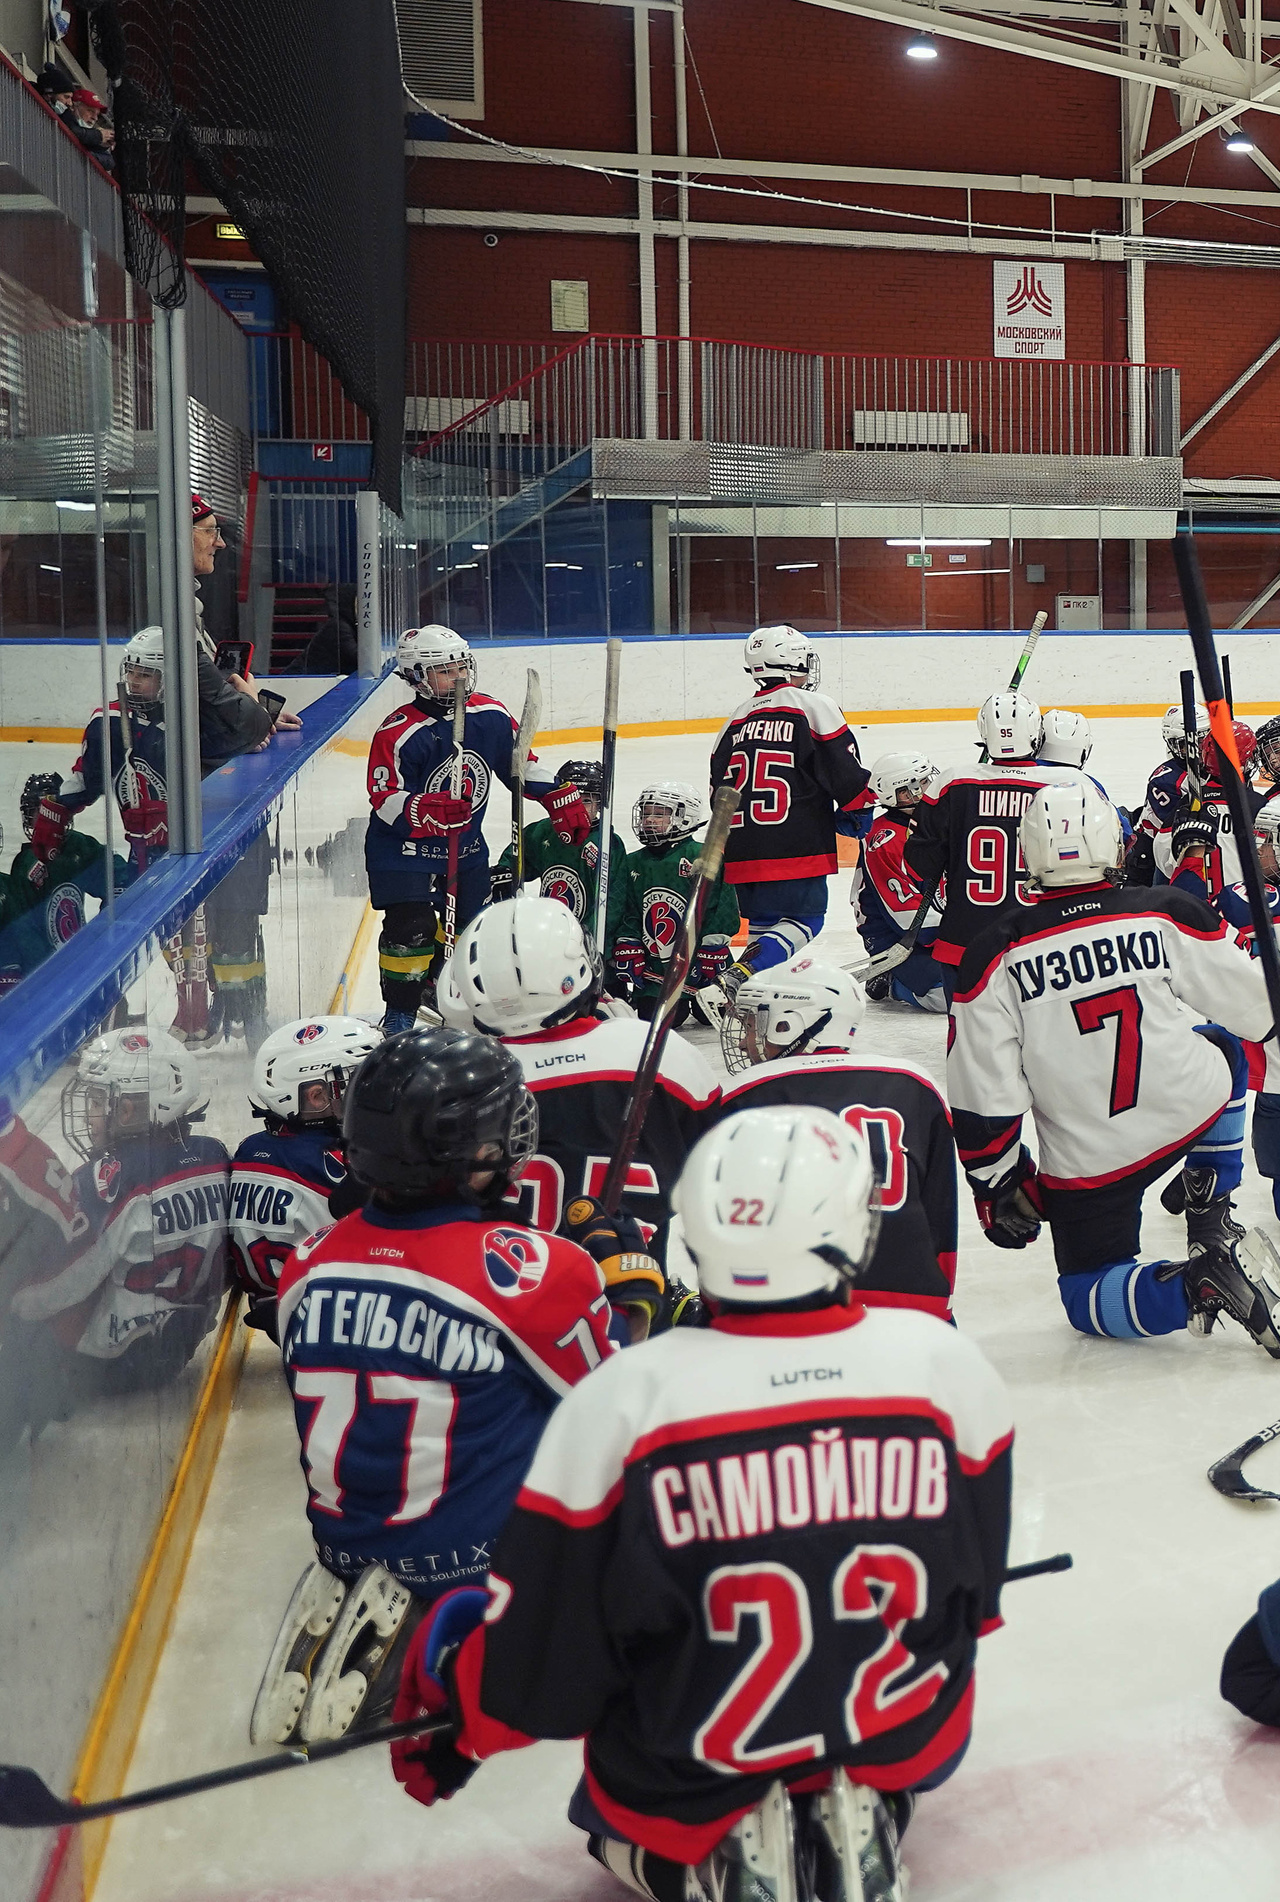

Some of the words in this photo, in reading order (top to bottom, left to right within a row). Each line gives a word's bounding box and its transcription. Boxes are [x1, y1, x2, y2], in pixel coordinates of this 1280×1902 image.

[997, 325, 1062, 340] МОСКОВСКИЙ
[1014, 341, 1045, 354] СПОРТ
[362, 542, 372, 628] СПОРТМАКС
[1000, 728, 1013, 738] 95
[1061, 818, 1070, 835] 7
[1061, 901, 1102, 917] LUTCH
[1069, 982, 1144, 1119] 7
[299, 1062, 333, 1073] CCM
[534, 1051, 587, 1069] LUTCH
[730, 1199, 763, 1227] 22
[369, 1247, 406, 1259] LUTCH
[770, 1366, 844, 1388] LUTCH
[291, 1364, 460, 1528] 77
[651, 1427, 949, 1548] САМОЙЛОВ
[692, 1542, 951, 1776] 22
